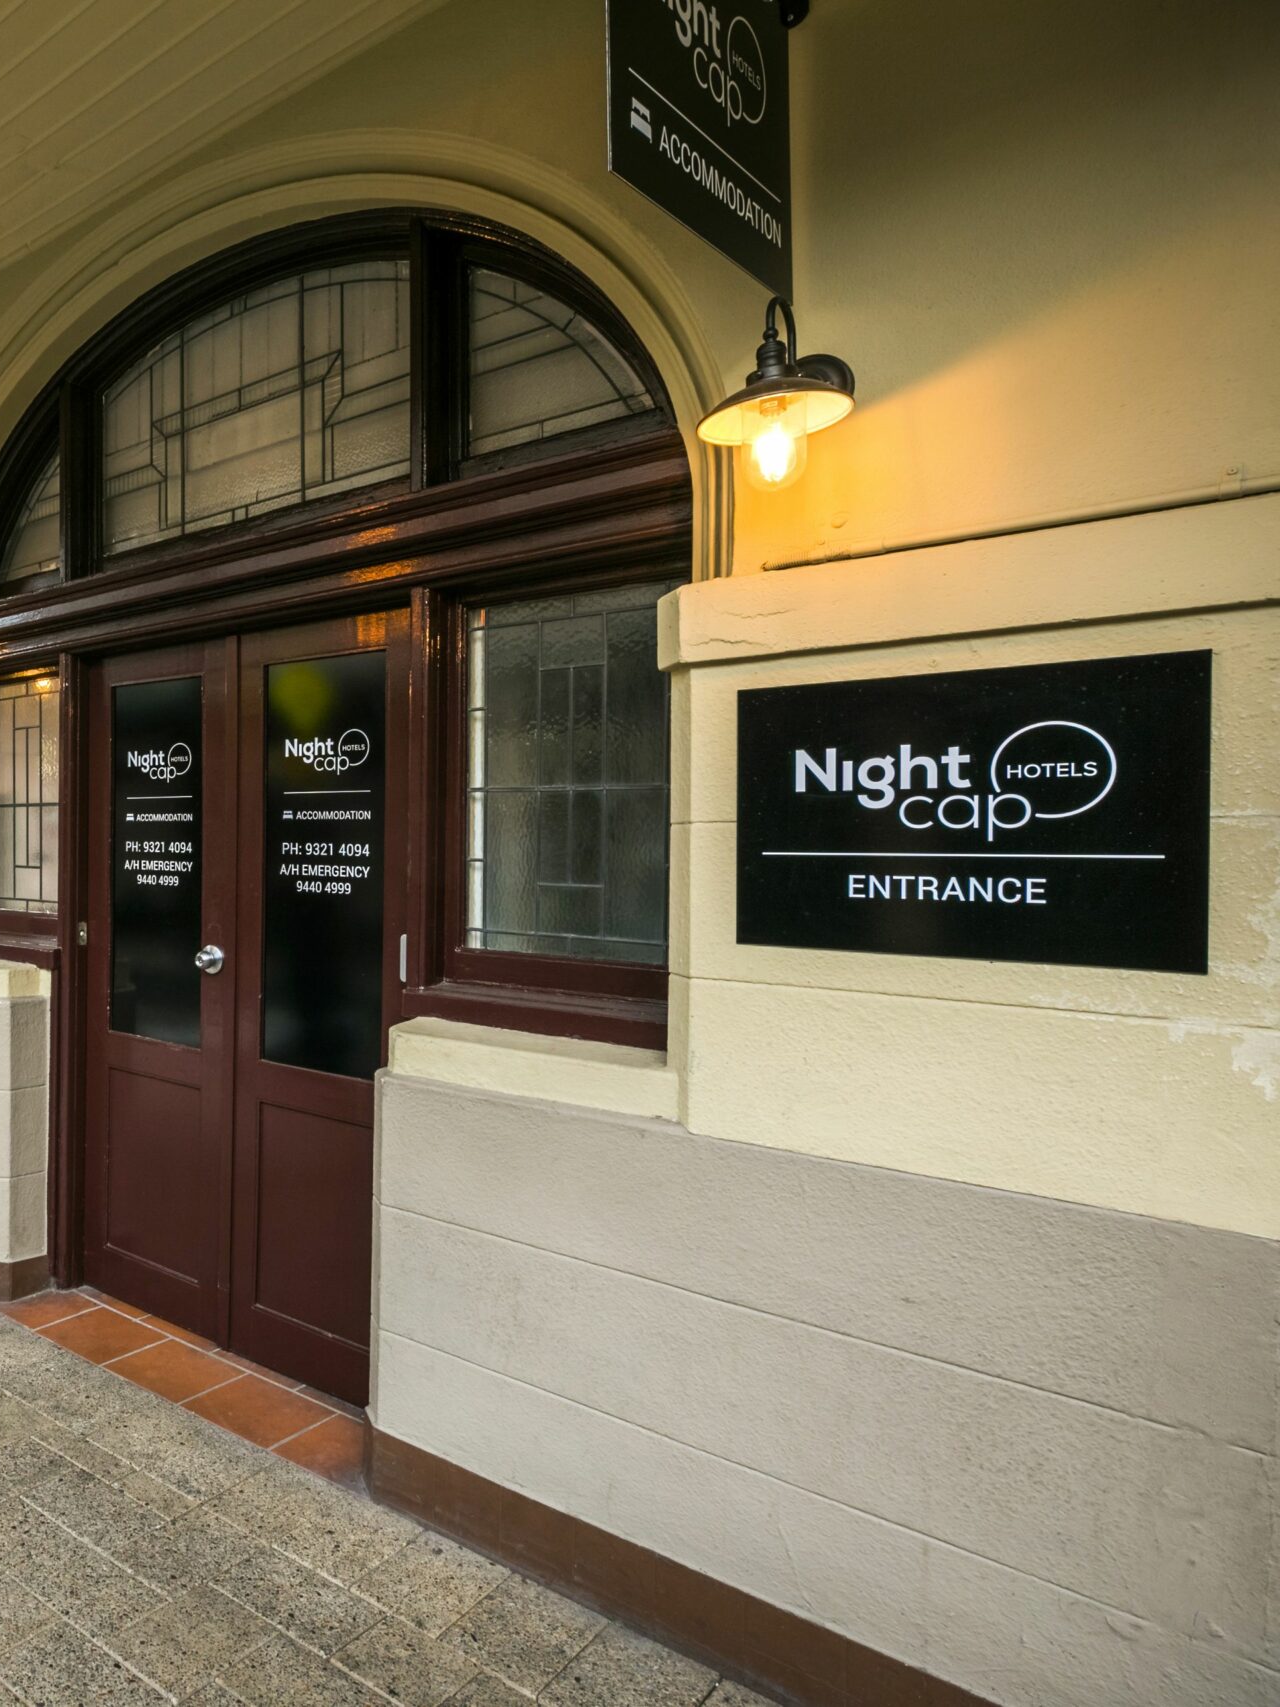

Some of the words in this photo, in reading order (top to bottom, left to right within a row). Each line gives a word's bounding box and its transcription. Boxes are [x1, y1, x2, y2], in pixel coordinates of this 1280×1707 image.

[663, 0, 721, 58] ght
[732, 51, 761, 90] HOTELS
[693, 47, 742, 127] cap
[660, 125, 782, 248] ACCOMMODATION
[284, 737, 334, 764] Night
[342, 743, 366, 752] HOTELS
[127, 749, 166, 773] Night
[170, 755, 189, 763] HOTELS
[314, 755, 350, 776] cap
[149, 766, 177, 783] cap
[795, 744, 972, 809] Night
[1006, 761, 1098, 779] HOTELS
[136, 813, 193, 821] ACCOMMODATION
[296, 810, 371, 820] ACCOMMODATION
[899, 793, 1031, 842] cap
[125, 840, 141, 852] PH:
[143, 841, 165, 853] 9321
[168, 841, 192, 853] 4094
[282, 842, 302, 855] PH:
[305, 843, 333, 856] 9321
[338, 843, 370, 857] 4094
[124, 859, 140, 870] A/H
[141, 860, 193, 872] EMERGENCY
[279, 864, 300, 876] A/H
[301, 864, 370, 878] EMERGENCY
[136, 874, 157, 885] 9440
[158, 875, 179, 886] 4999
[296, 881, 322, 893] 9440
[324, 882, 352, 895] 4999
[848, 874, 1047, 904] ENTRANCE
